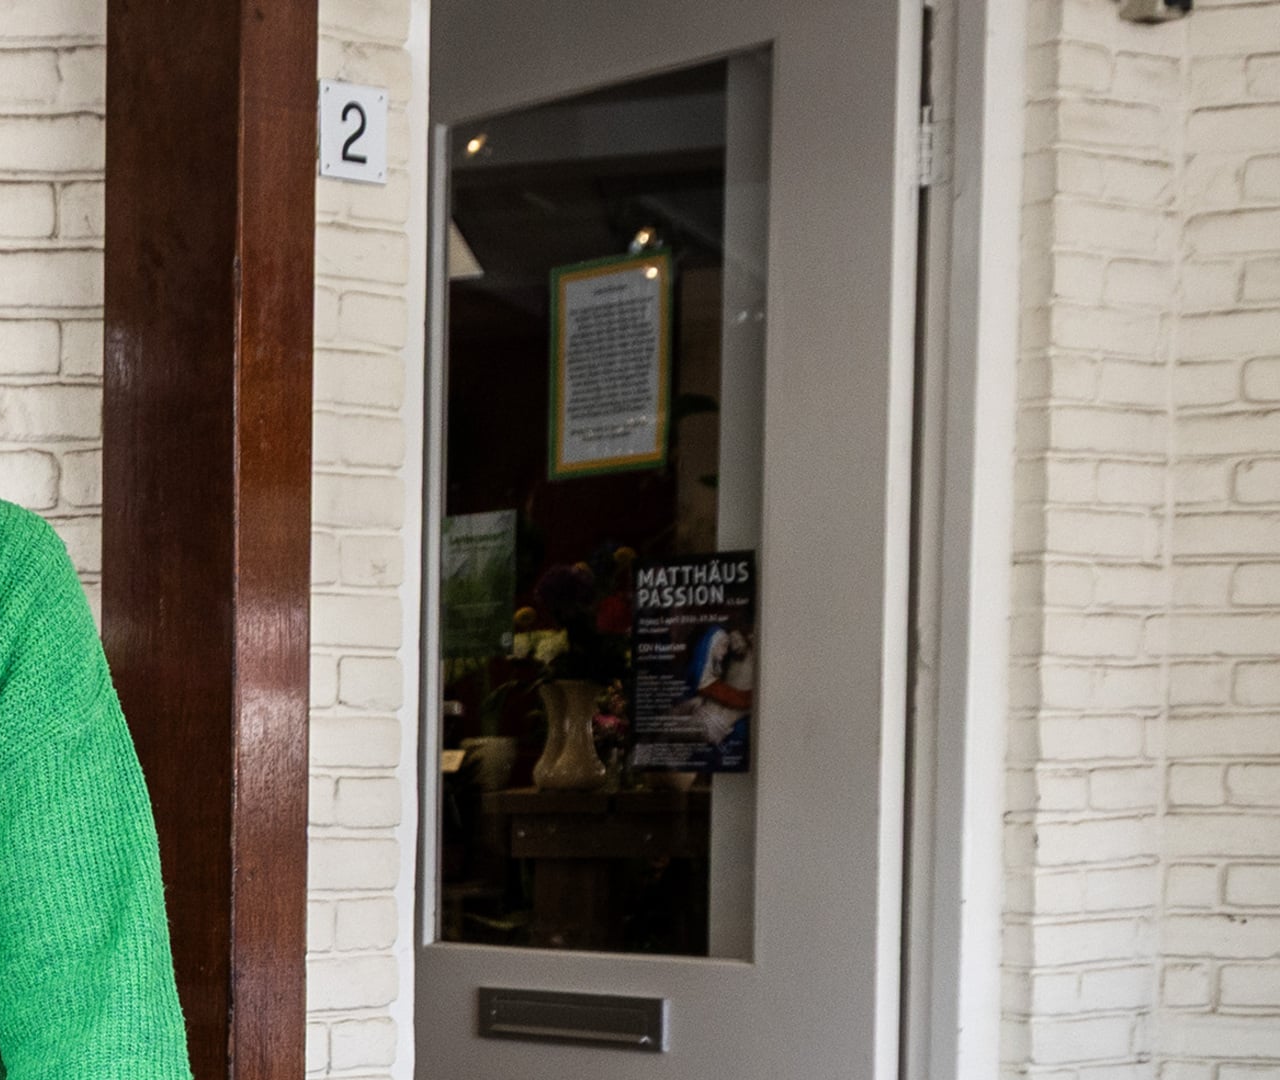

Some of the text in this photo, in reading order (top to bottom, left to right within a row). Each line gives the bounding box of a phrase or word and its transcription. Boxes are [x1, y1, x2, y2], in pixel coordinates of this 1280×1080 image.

[341, 101, 367, 164] 2
[637, 560, 750, 589] MATTHÄUS
[637, 585, 725, 609] PASSION
